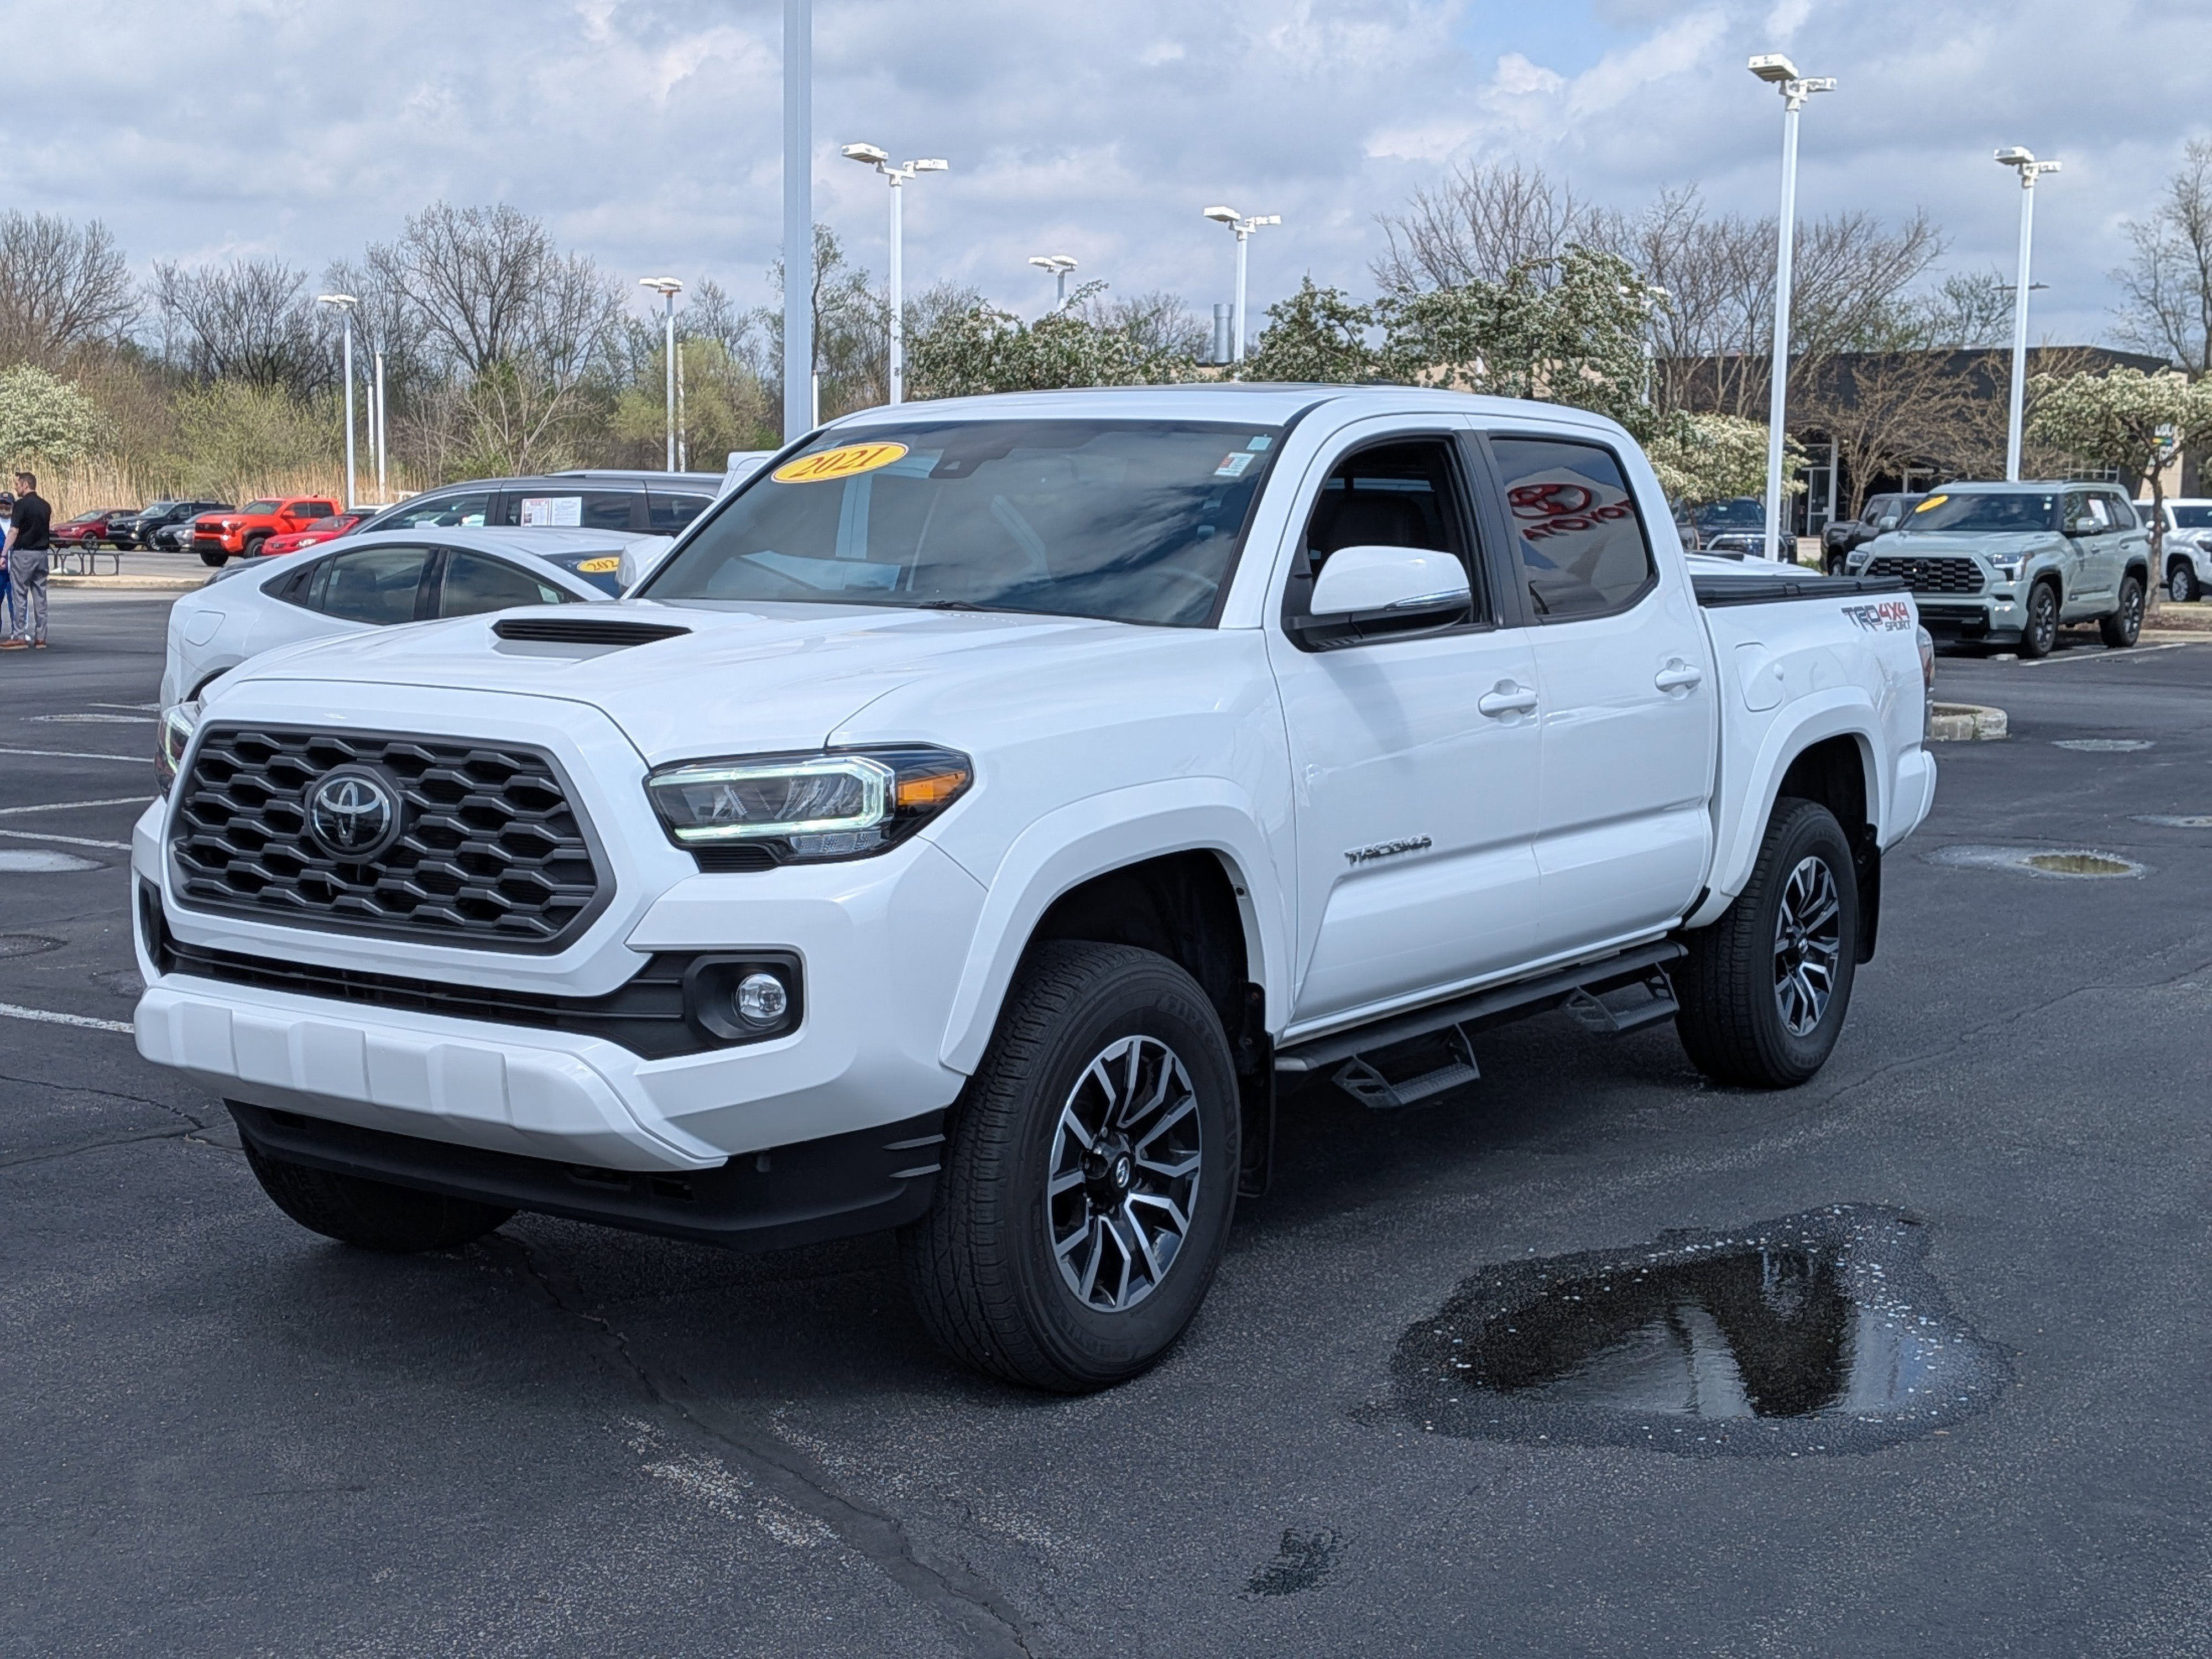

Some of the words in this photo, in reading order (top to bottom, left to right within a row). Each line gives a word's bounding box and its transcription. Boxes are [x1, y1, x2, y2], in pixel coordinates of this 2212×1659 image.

[788, 446, 889, 478] 2021
[586, 560, 618, 571] 202
[1841, 605, 1883, 632] TRD
[1885, 620, 1911, 632] SPORT
[1344, 833, 1432, 865] TACOMA
